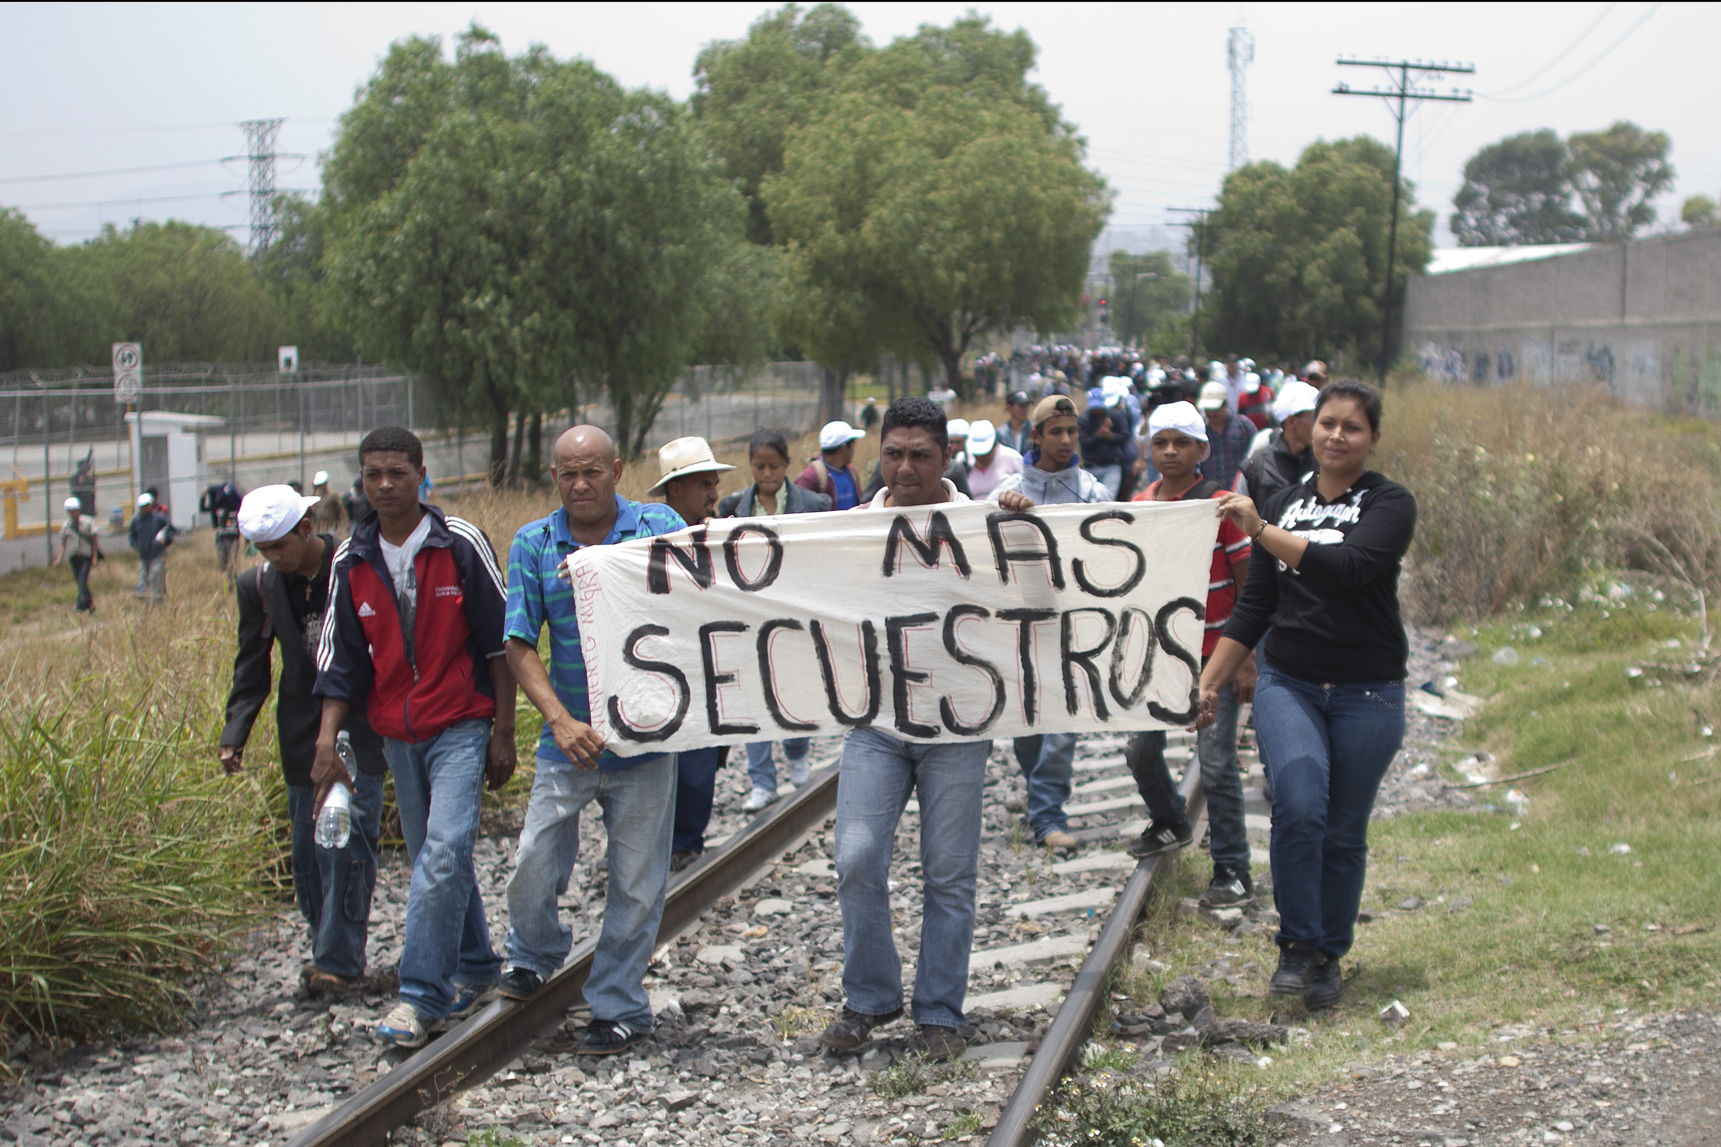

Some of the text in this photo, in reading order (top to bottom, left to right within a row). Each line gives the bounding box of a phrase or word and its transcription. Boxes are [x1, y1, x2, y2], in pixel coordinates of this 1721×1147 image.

[647, 510, 1146, 598] NO MAS
[608, 597, 1205, 742] SECUESTROS
